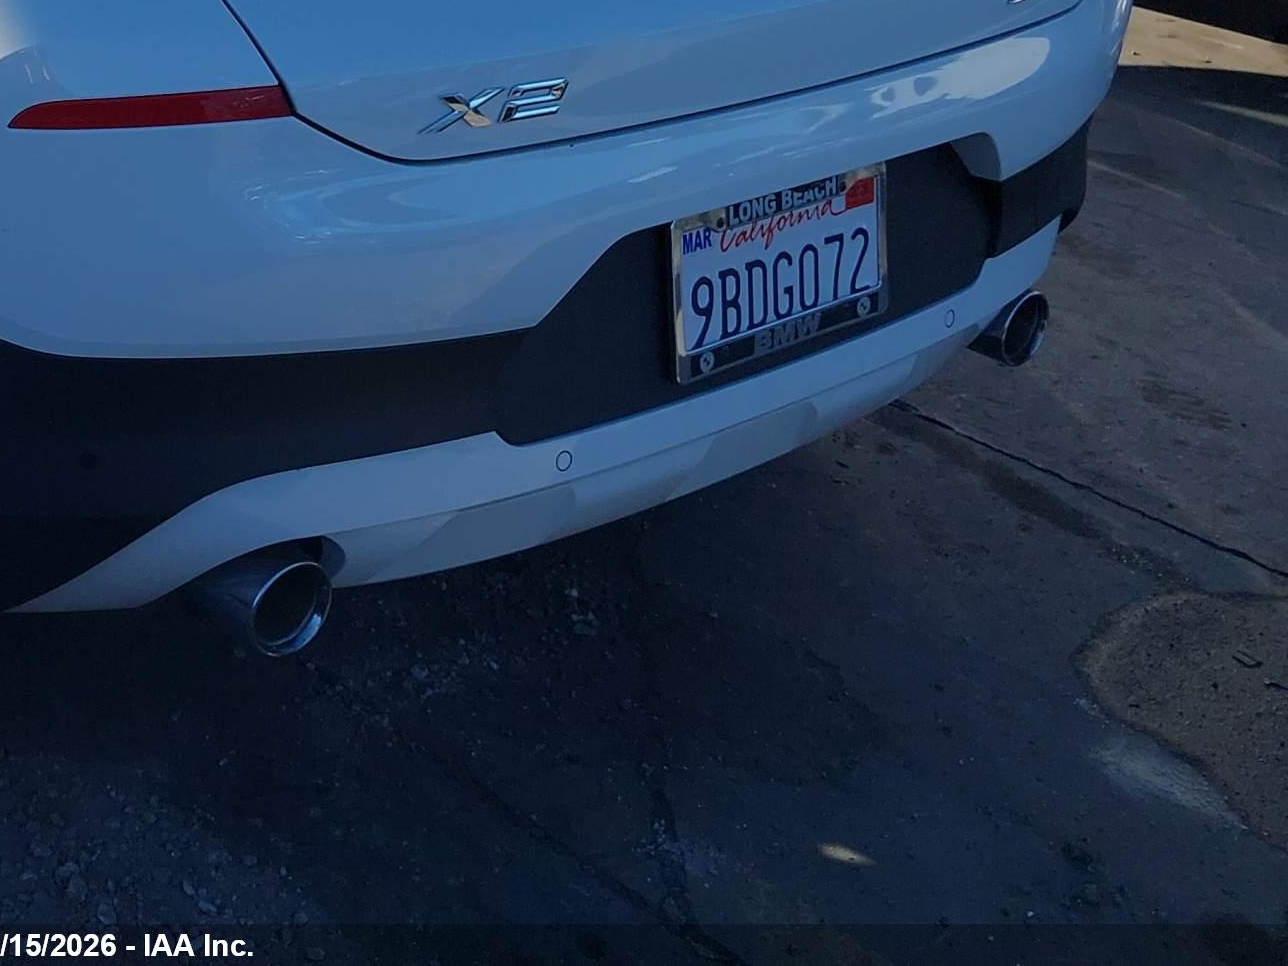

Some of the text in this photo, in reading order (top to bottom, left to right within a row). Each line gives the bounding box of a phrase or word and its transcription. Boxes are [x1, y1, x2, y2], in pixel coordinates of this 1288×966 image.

[417, 77, 570, 135] X2
[718, 198, 846, 252] California
[726, 196, 777, 225] LONG
[780, 175, 839, 208] BEACH
[682, 227, 712, 256] MAR
[687, 226, 871, 352] 9BDG072
[754, 313, 822, 352] BMW
